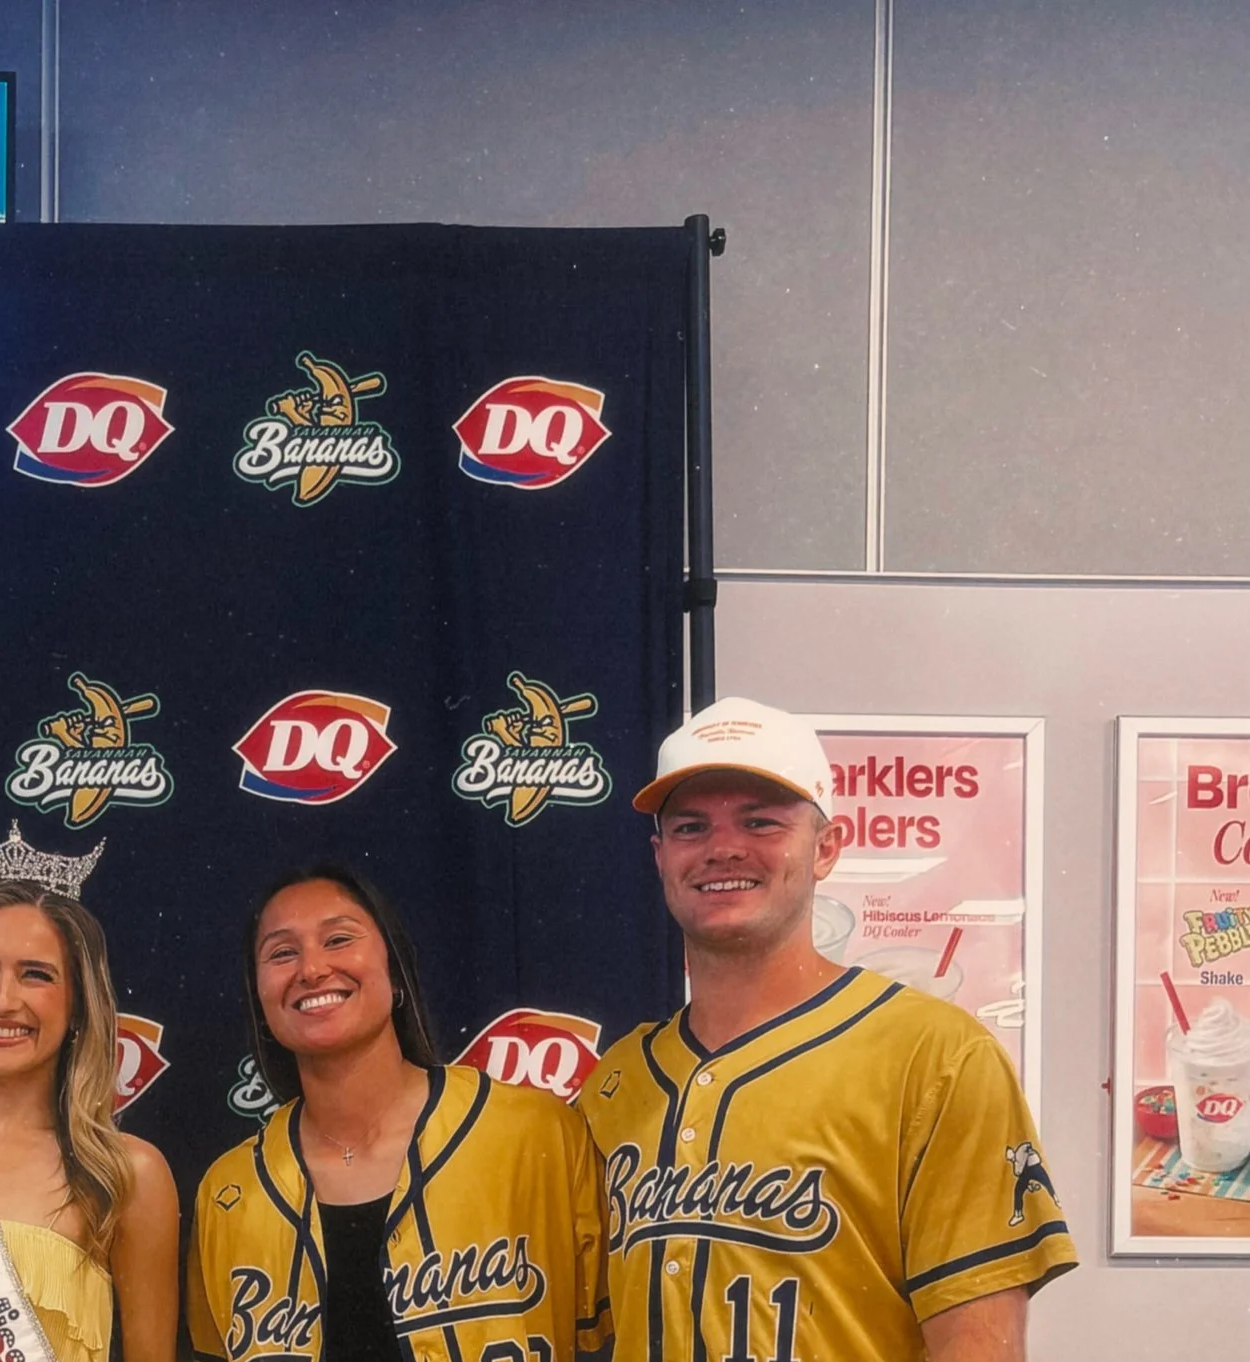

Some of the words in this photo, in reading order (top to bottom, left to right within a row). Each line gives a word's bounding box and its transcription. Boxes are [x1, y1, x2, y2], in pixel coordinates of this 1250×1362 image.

[36, 400, 147, 460] DQ
[291, 427, 375, 437] SAVANNAH
[476, 403, 584, 465] DQ
[238, 421, 393, 482] Bananas
[63, 749, 148, 759] SAVANNAH
[261, 718, 371, 779] DQ
[502, 748, 586, 758] SAVANNAH
[10, 744, 166, 805] Bananas
[456, 739, 604, 800] Bananas
[862, 895, 892, 908] New!
[1210, 889, 1240, 902] New!
[862, 910, 922, 923] Hibiscus
[862, 926, 883, 939] DQ
[884, 926, 922, 938] Cooler
[1200, 970, 1244, 985] Shake
[486, 1036, 579, 1097] DQ
[1203, 1099, 1238, 1117] DQ
[607, 1142, 841, 1261] Bananas
